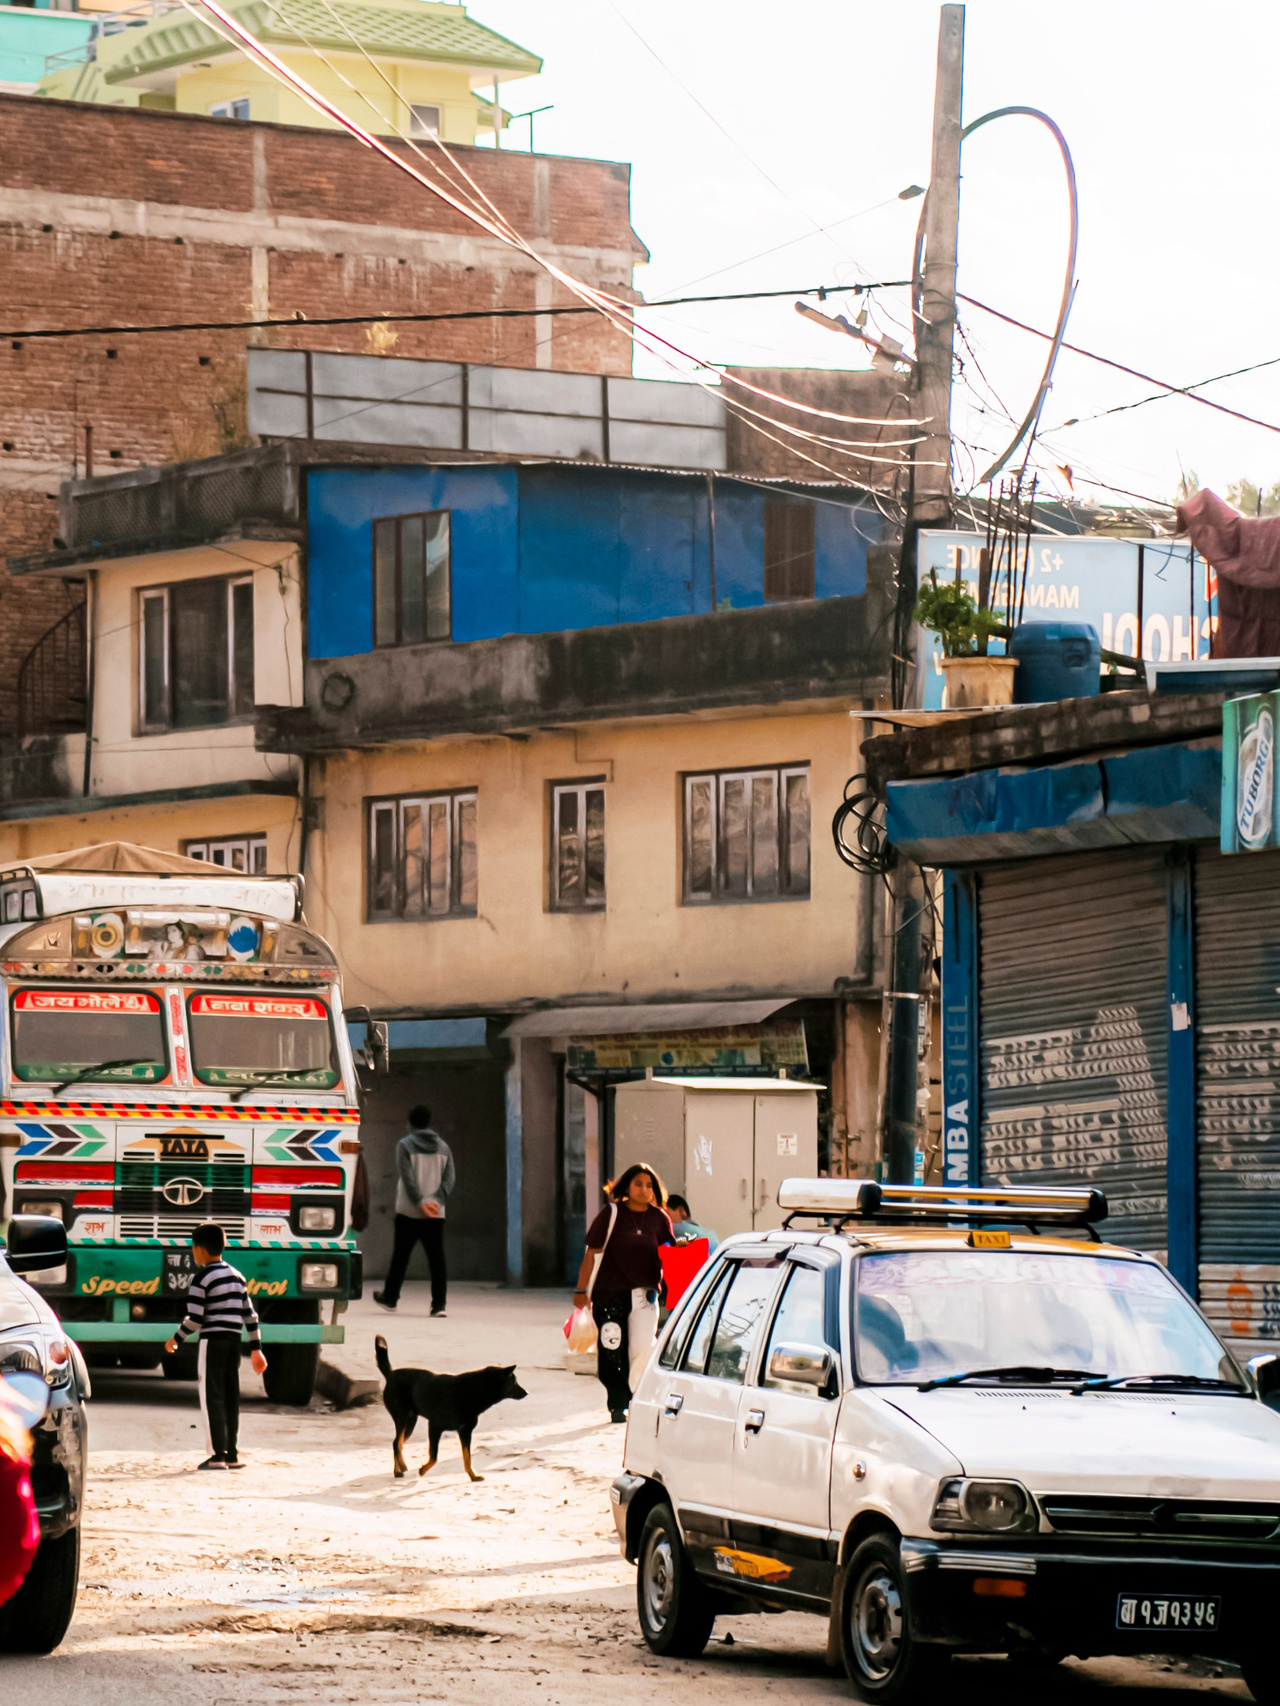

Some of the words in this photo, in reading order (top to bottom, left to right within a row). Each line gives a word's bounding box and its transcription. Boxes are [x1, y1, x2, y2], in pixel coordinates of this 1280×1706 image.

[1239, 741, 1270, 831] TUBORG
[947, 994, 969, 1096] STEEL
[160, 1138, 209, 1156] TATA
[976, 1234, 1007, 1245] TAXI
[81, 1275, 161, 1296] Speed
